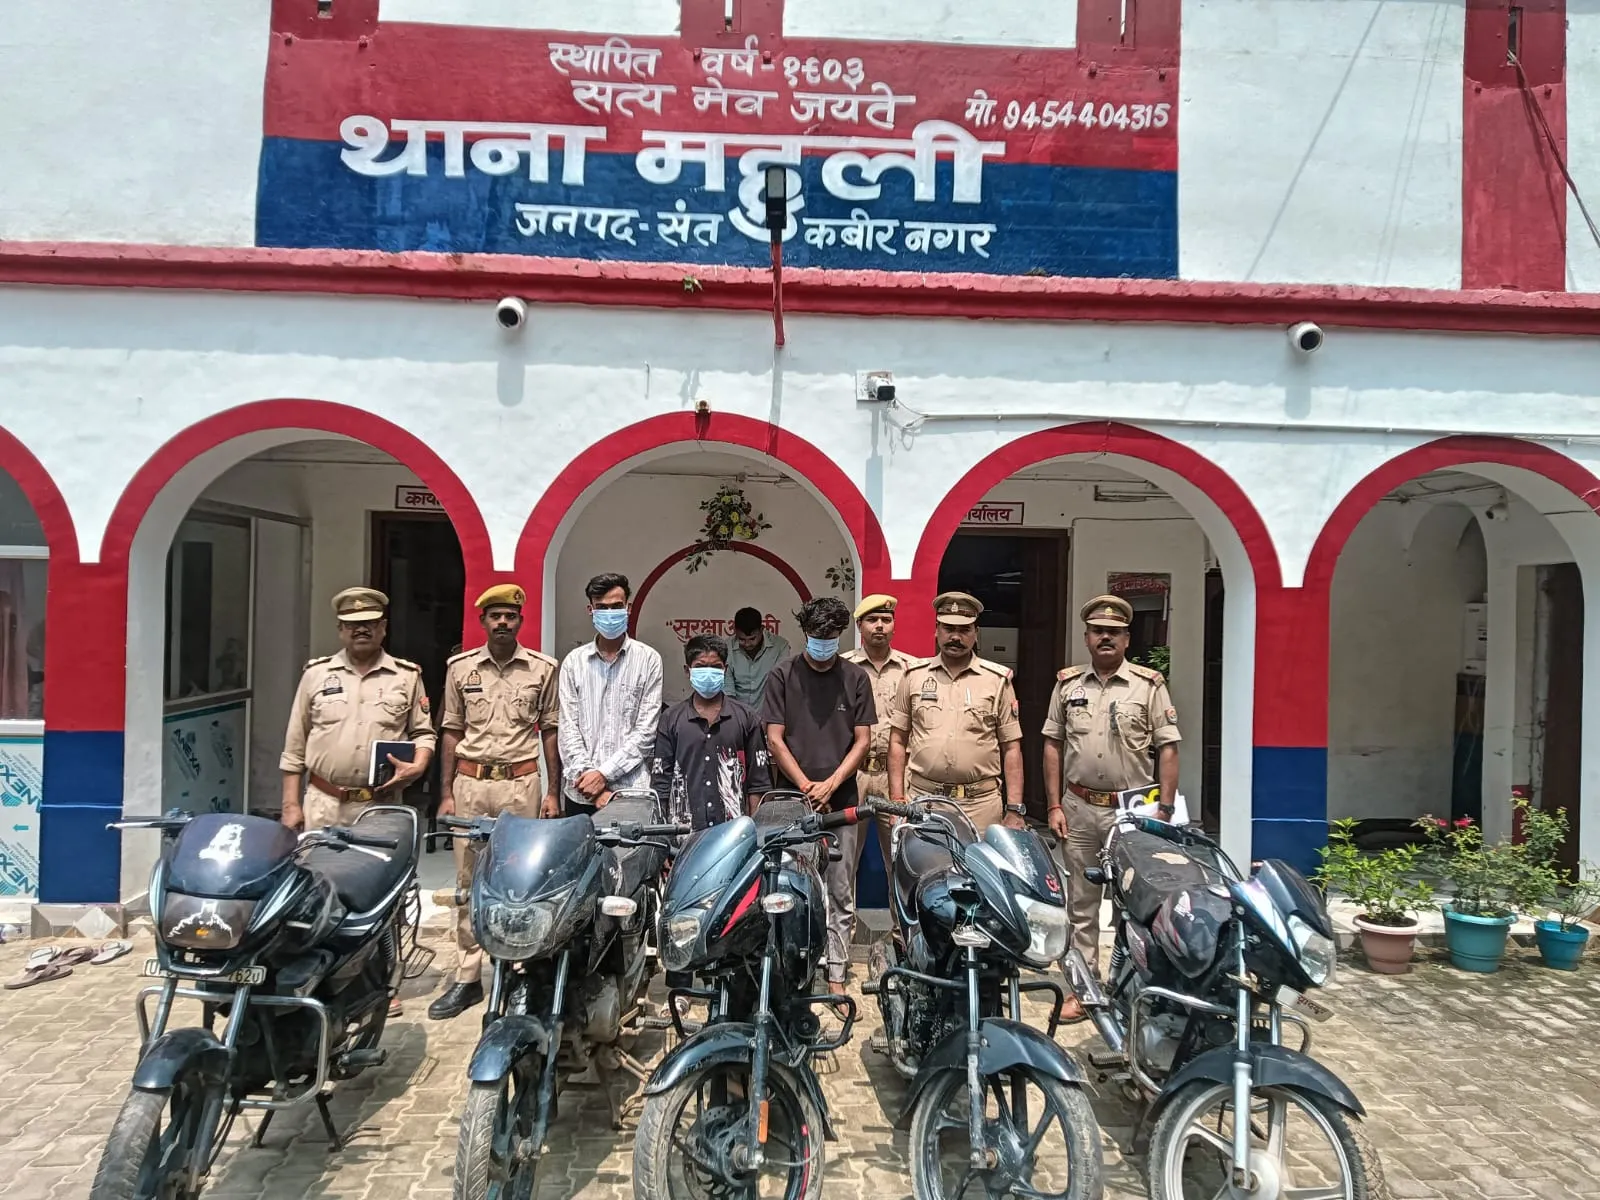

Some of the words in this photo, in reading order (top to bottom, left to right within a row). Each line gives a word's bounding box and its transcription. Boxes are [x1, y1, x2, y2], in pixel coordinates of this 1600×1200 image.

[547, 36, 662, 79] स्थापित
[570, 79, 677, 118] सत्य
[691, 76, 779, 118] मेव
[790, 82, 916, 129] जयते
[1003, 99, 1171, 130] 9454404315
[339, 114, 607, 187] थाना
[635, 119, 1005, 242] महुली
[656, 198, 724, 247] संत
[802, 207, 900, 255] कबीर
[904, 221, 997, 258] नगर
